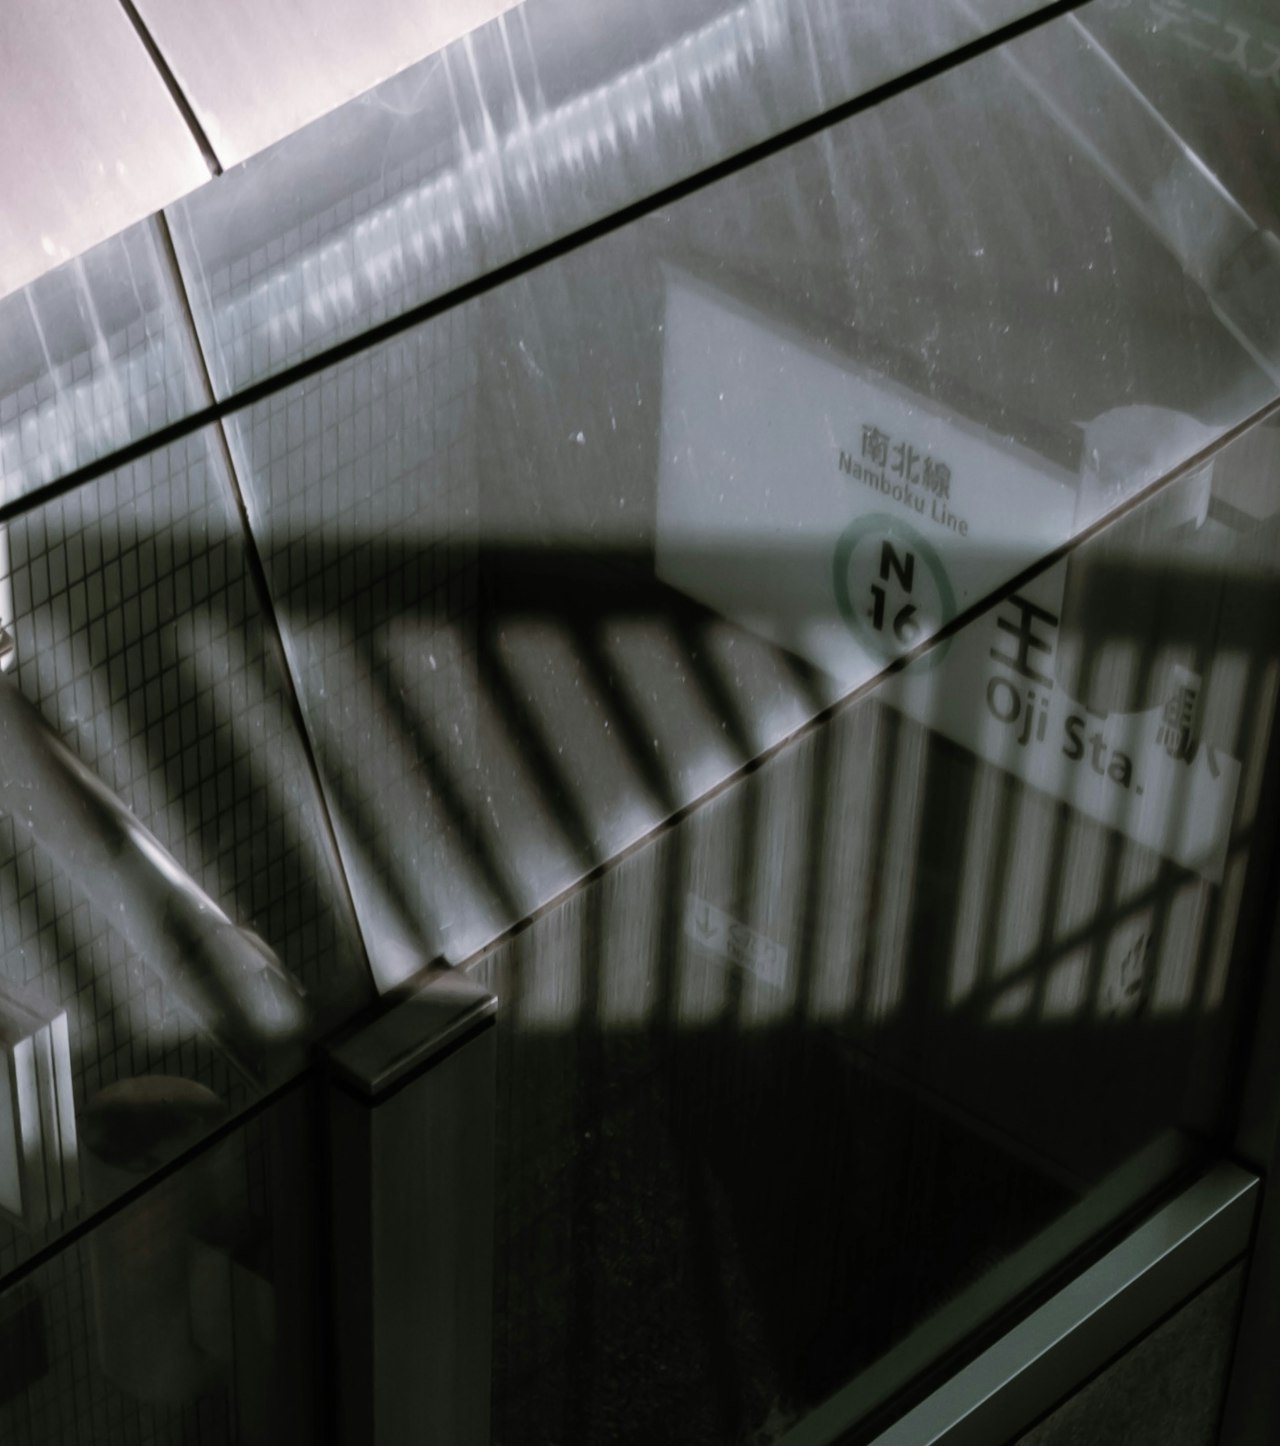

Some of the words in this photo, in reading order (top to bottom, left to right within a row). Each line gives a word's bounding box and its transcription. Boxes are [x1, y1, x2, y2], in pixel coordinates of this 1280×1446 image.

[837, 451, 928, 516] Namboku
[930, 499, 969, 538] Line
[860, 422, 952, 499] 南北線
[879, 540, 915, 594] N
[867, 584, 922, 645] 16
[990, 594, 1223, 778] 王駅
[985, 678, 1051, 747] Oji
[1062, 714, 1144, 795] Sta.
